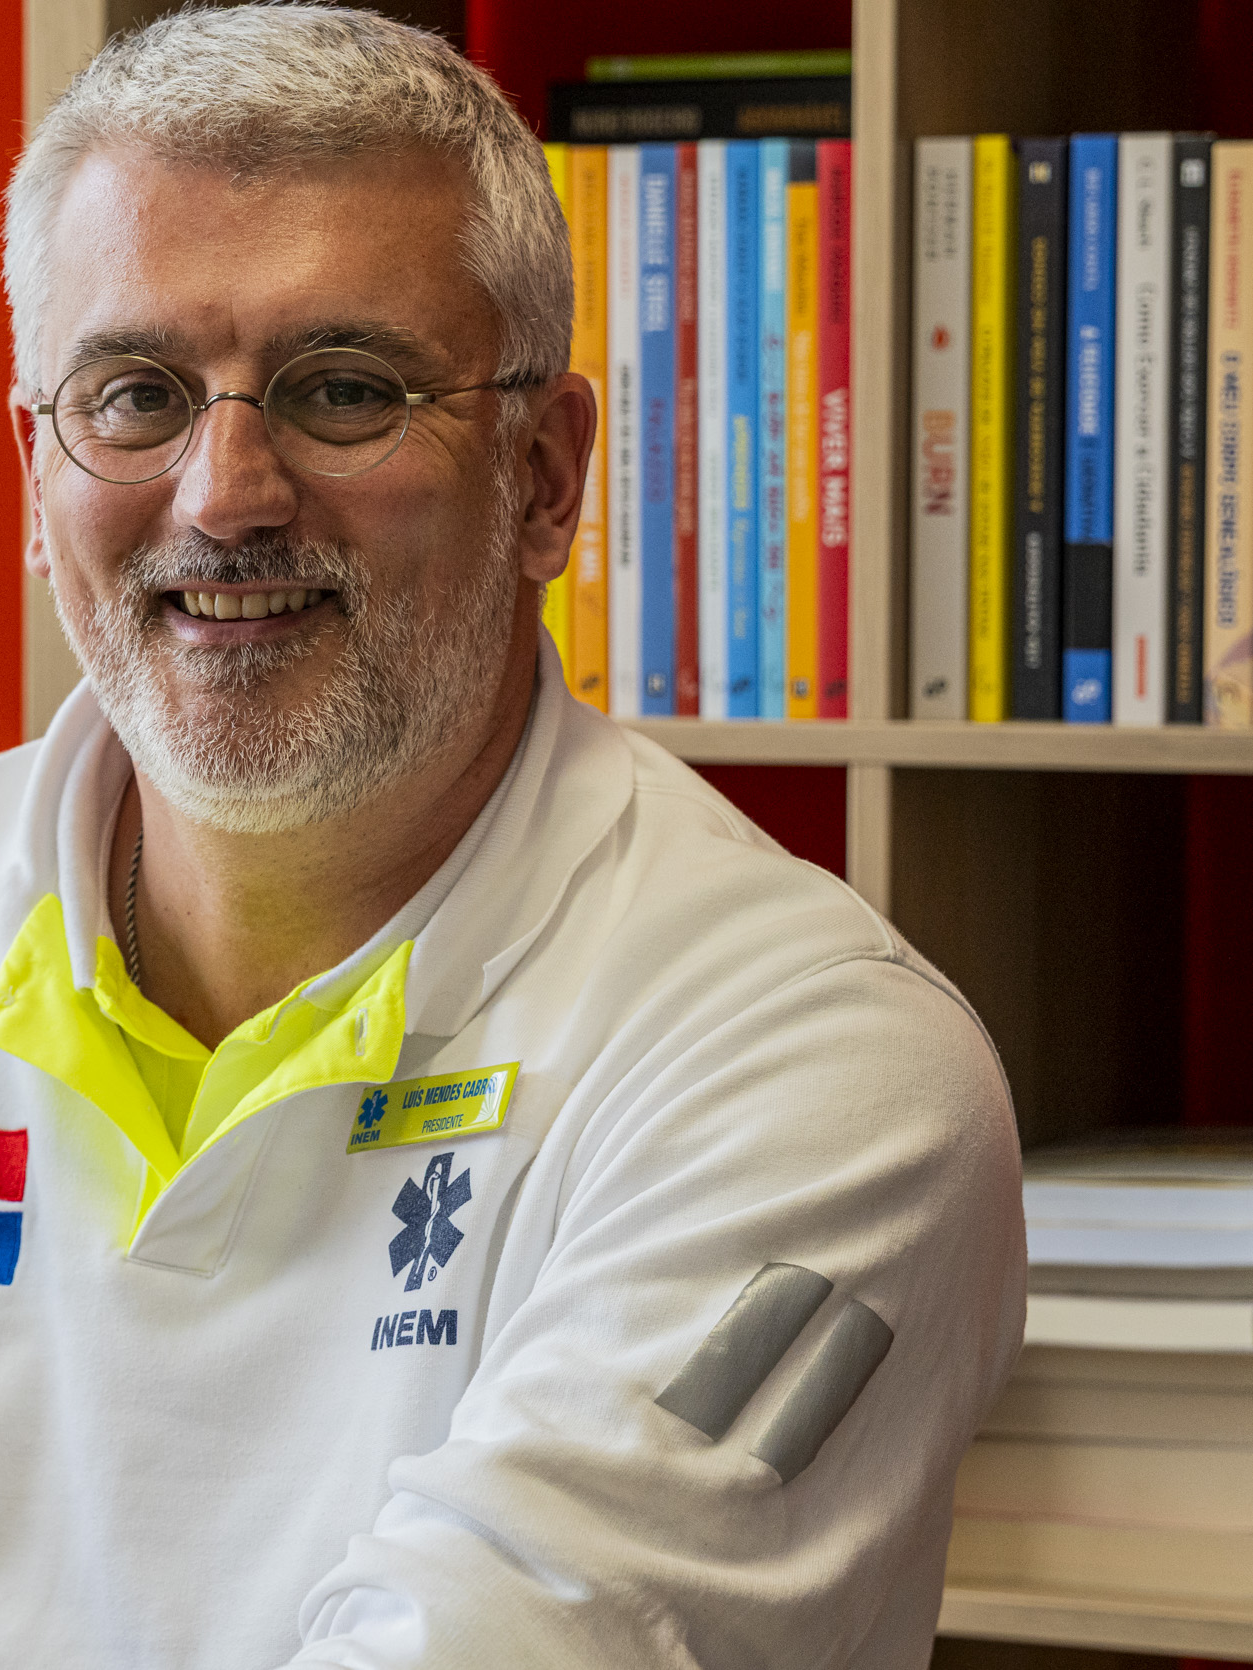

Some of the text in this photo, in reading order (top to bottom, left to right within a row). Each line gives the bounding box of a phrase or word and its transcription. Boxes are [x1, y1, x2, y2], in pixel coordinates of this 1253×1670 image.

[644, 175, 668, 334] DANIELLE STEEL
[1136, 283, 1158, 348] Como
[822, 389, 847, 547] VIVER MAIS
[922, 409, 956, 516] BURN
[1133, 463, 1157, 576] Cidadania
[402, 1085, 424, 1109] LUÍS
[424, 1082, 462, 1106] MENDES
[421, 1114, 464, 1133] PRESIDENTE
[350, 1130, 380, 1145] INEM
[370, 1309, 458, 1351] INEM
